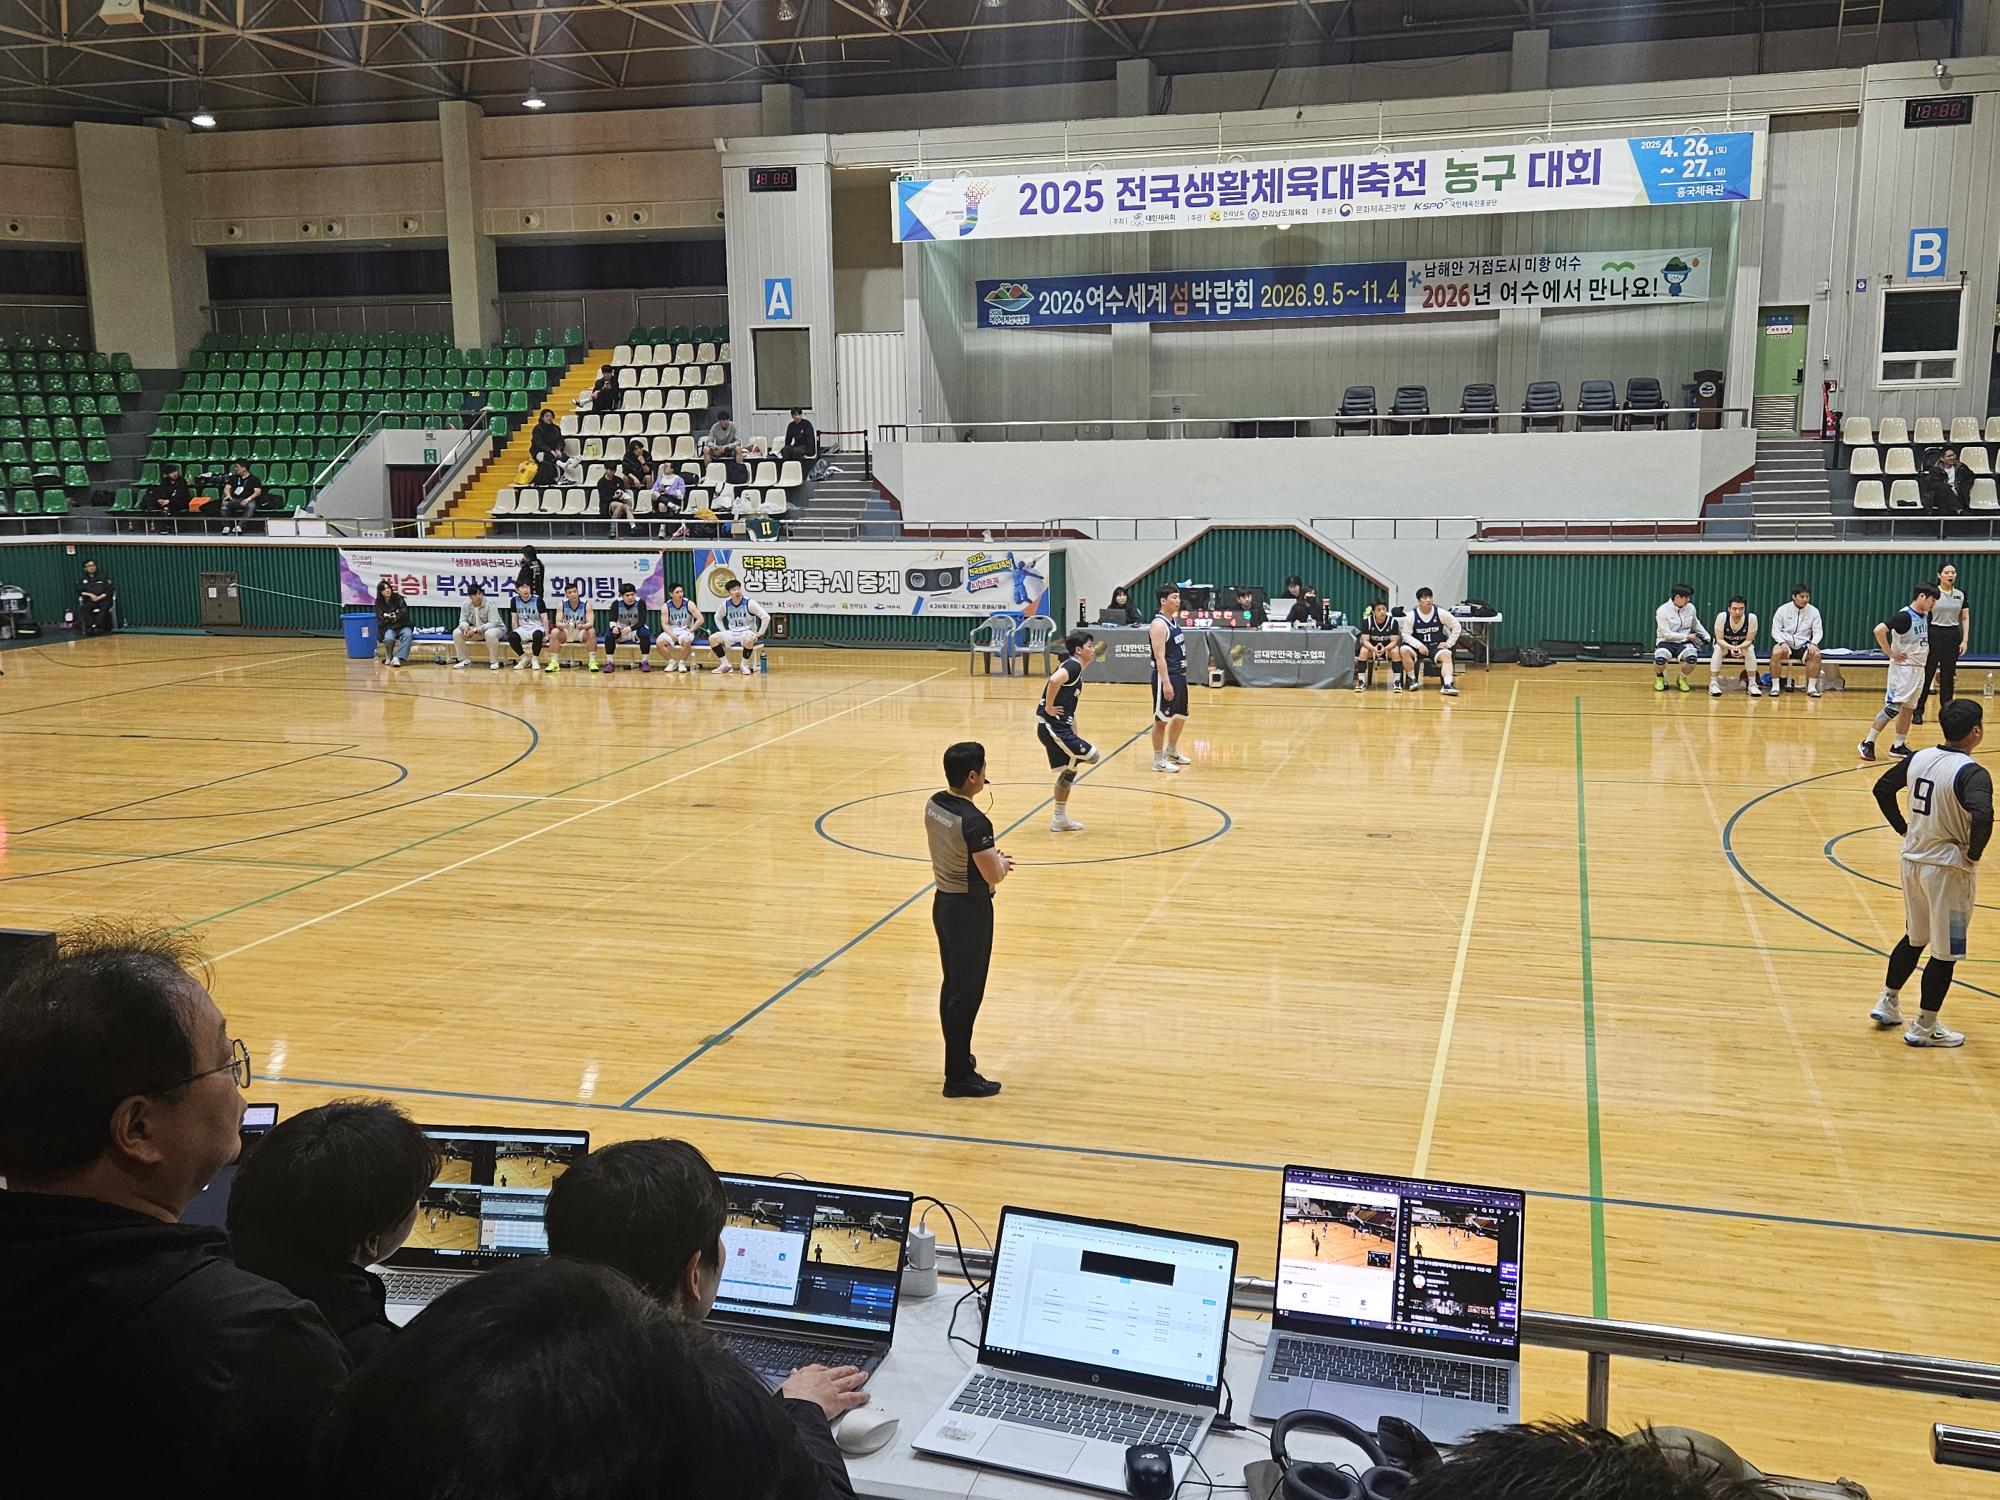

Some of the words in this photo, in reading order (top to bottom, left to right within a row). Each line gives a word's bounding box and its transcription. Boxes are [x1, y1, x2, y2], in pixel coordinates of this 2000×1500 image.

[1641, 141, 1661, 149] 2025
[1660, 138, 1678, 157] 4.
[1019, 179, 1104, 216] 2025
[1116, 159, 1426, 211] 전국생활체육대축전
[1445, 154, 1517, 195] 농구
[1527, 147, 1602, 188] 대회
[1677, 184, 1724, 198] 흥국체육관
[1262, 208, 1308, 218] 전라남도체육회
[1356, 203, 1406, 214] 문화체육관광부
[1413, 202, 1444, 211] KSPO
[1911, 232, 1941, 273] B
[1424, 259, 1463, 278] 남해안
[1468, 256, 1522, 277] 거점도시
[1525, 256, 1551, 272] 미항
[1555, 255, 1582, 272] 여수
[767, 282, 791, 316] A
[1422, 281, 1491, 308] 2026년
[1500, 277, 1581, 305] 여수에서
[1588, 276, 1658, 302] 만나요!
[742, 555, 786, 570] 전국최초
[379, 573, 428, 596] 필승!
[857, 570, 900, 595] 중계
[1912, 777, 1935, 817] 9
